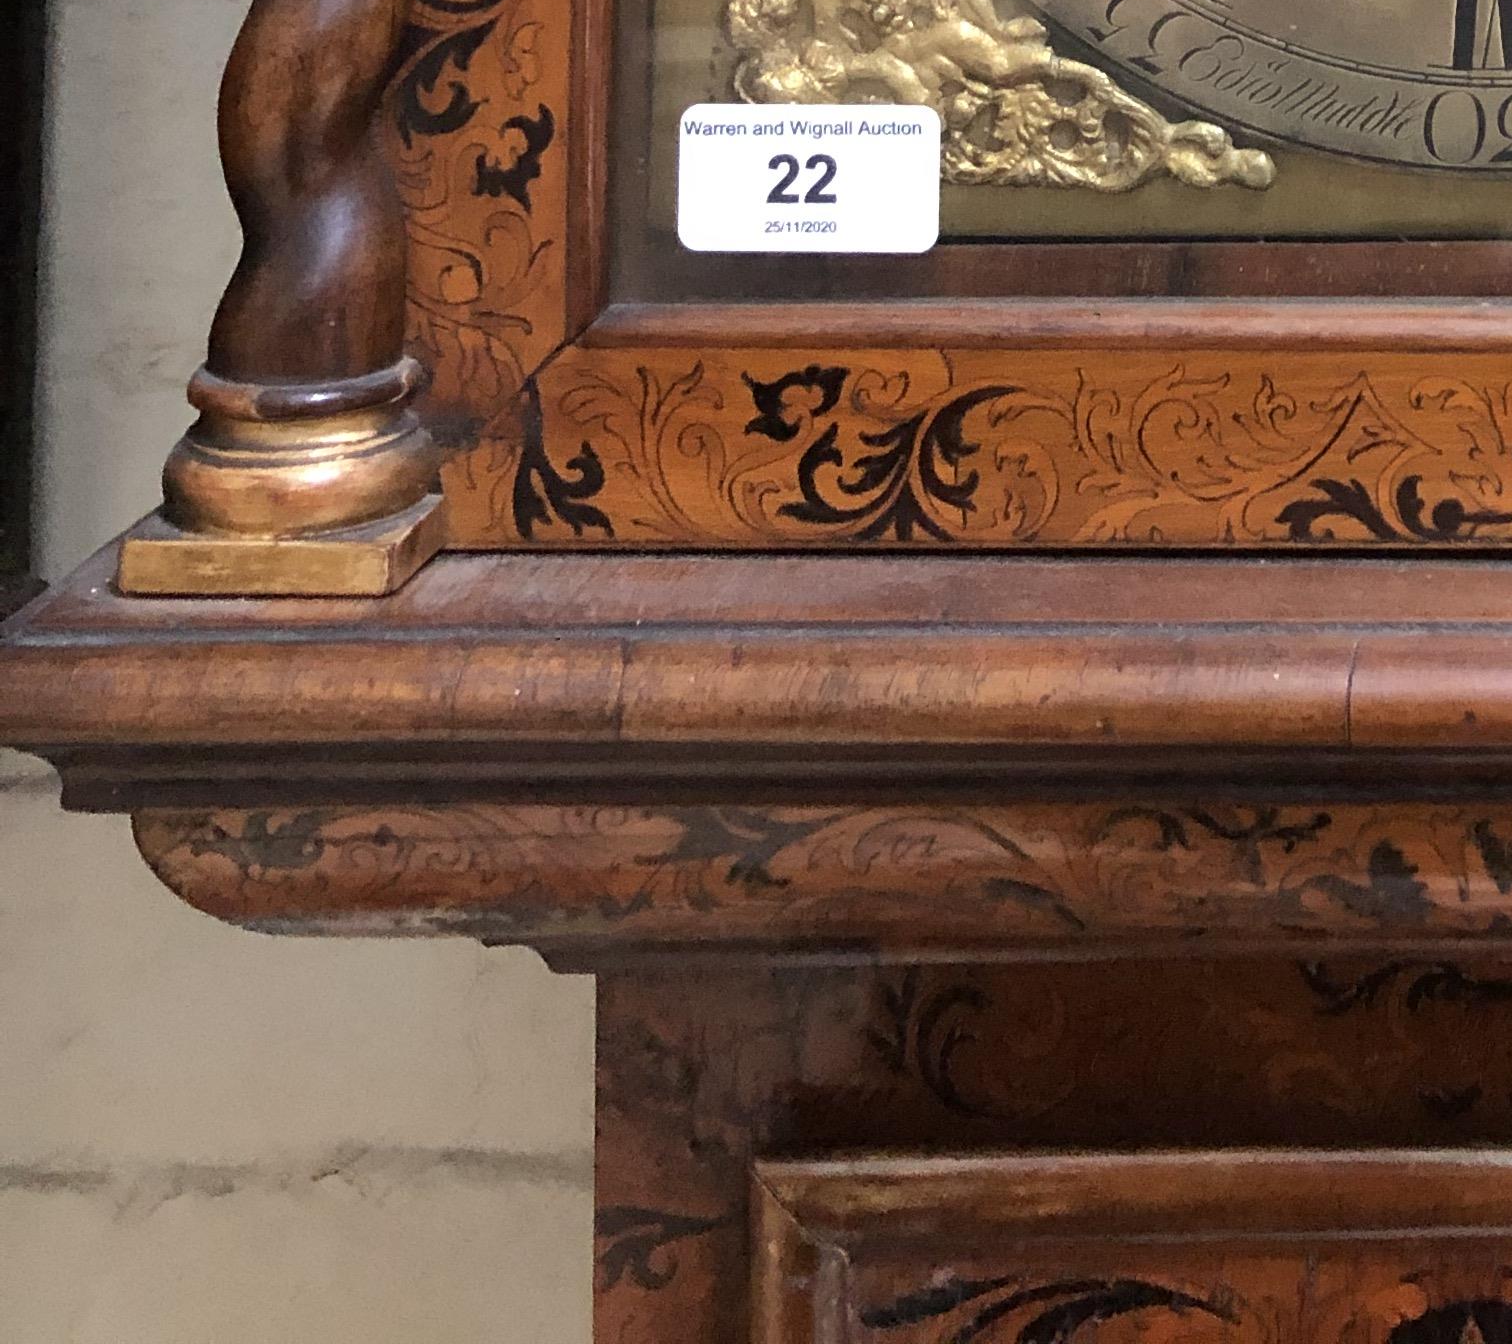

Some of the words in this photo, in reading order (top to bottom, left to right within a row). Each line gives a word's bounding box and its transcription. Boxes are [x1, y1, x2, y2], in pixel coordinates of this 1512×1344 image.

[684, 121, 747, 136] Warren
[753, 121, 784, 136] and
[790, 121, 852, 139] Wignall
[858, 120, 922, 136] Auction
[766, 153, 838, 204] 22
[764, 221, 837, 233] 25/11/2020
